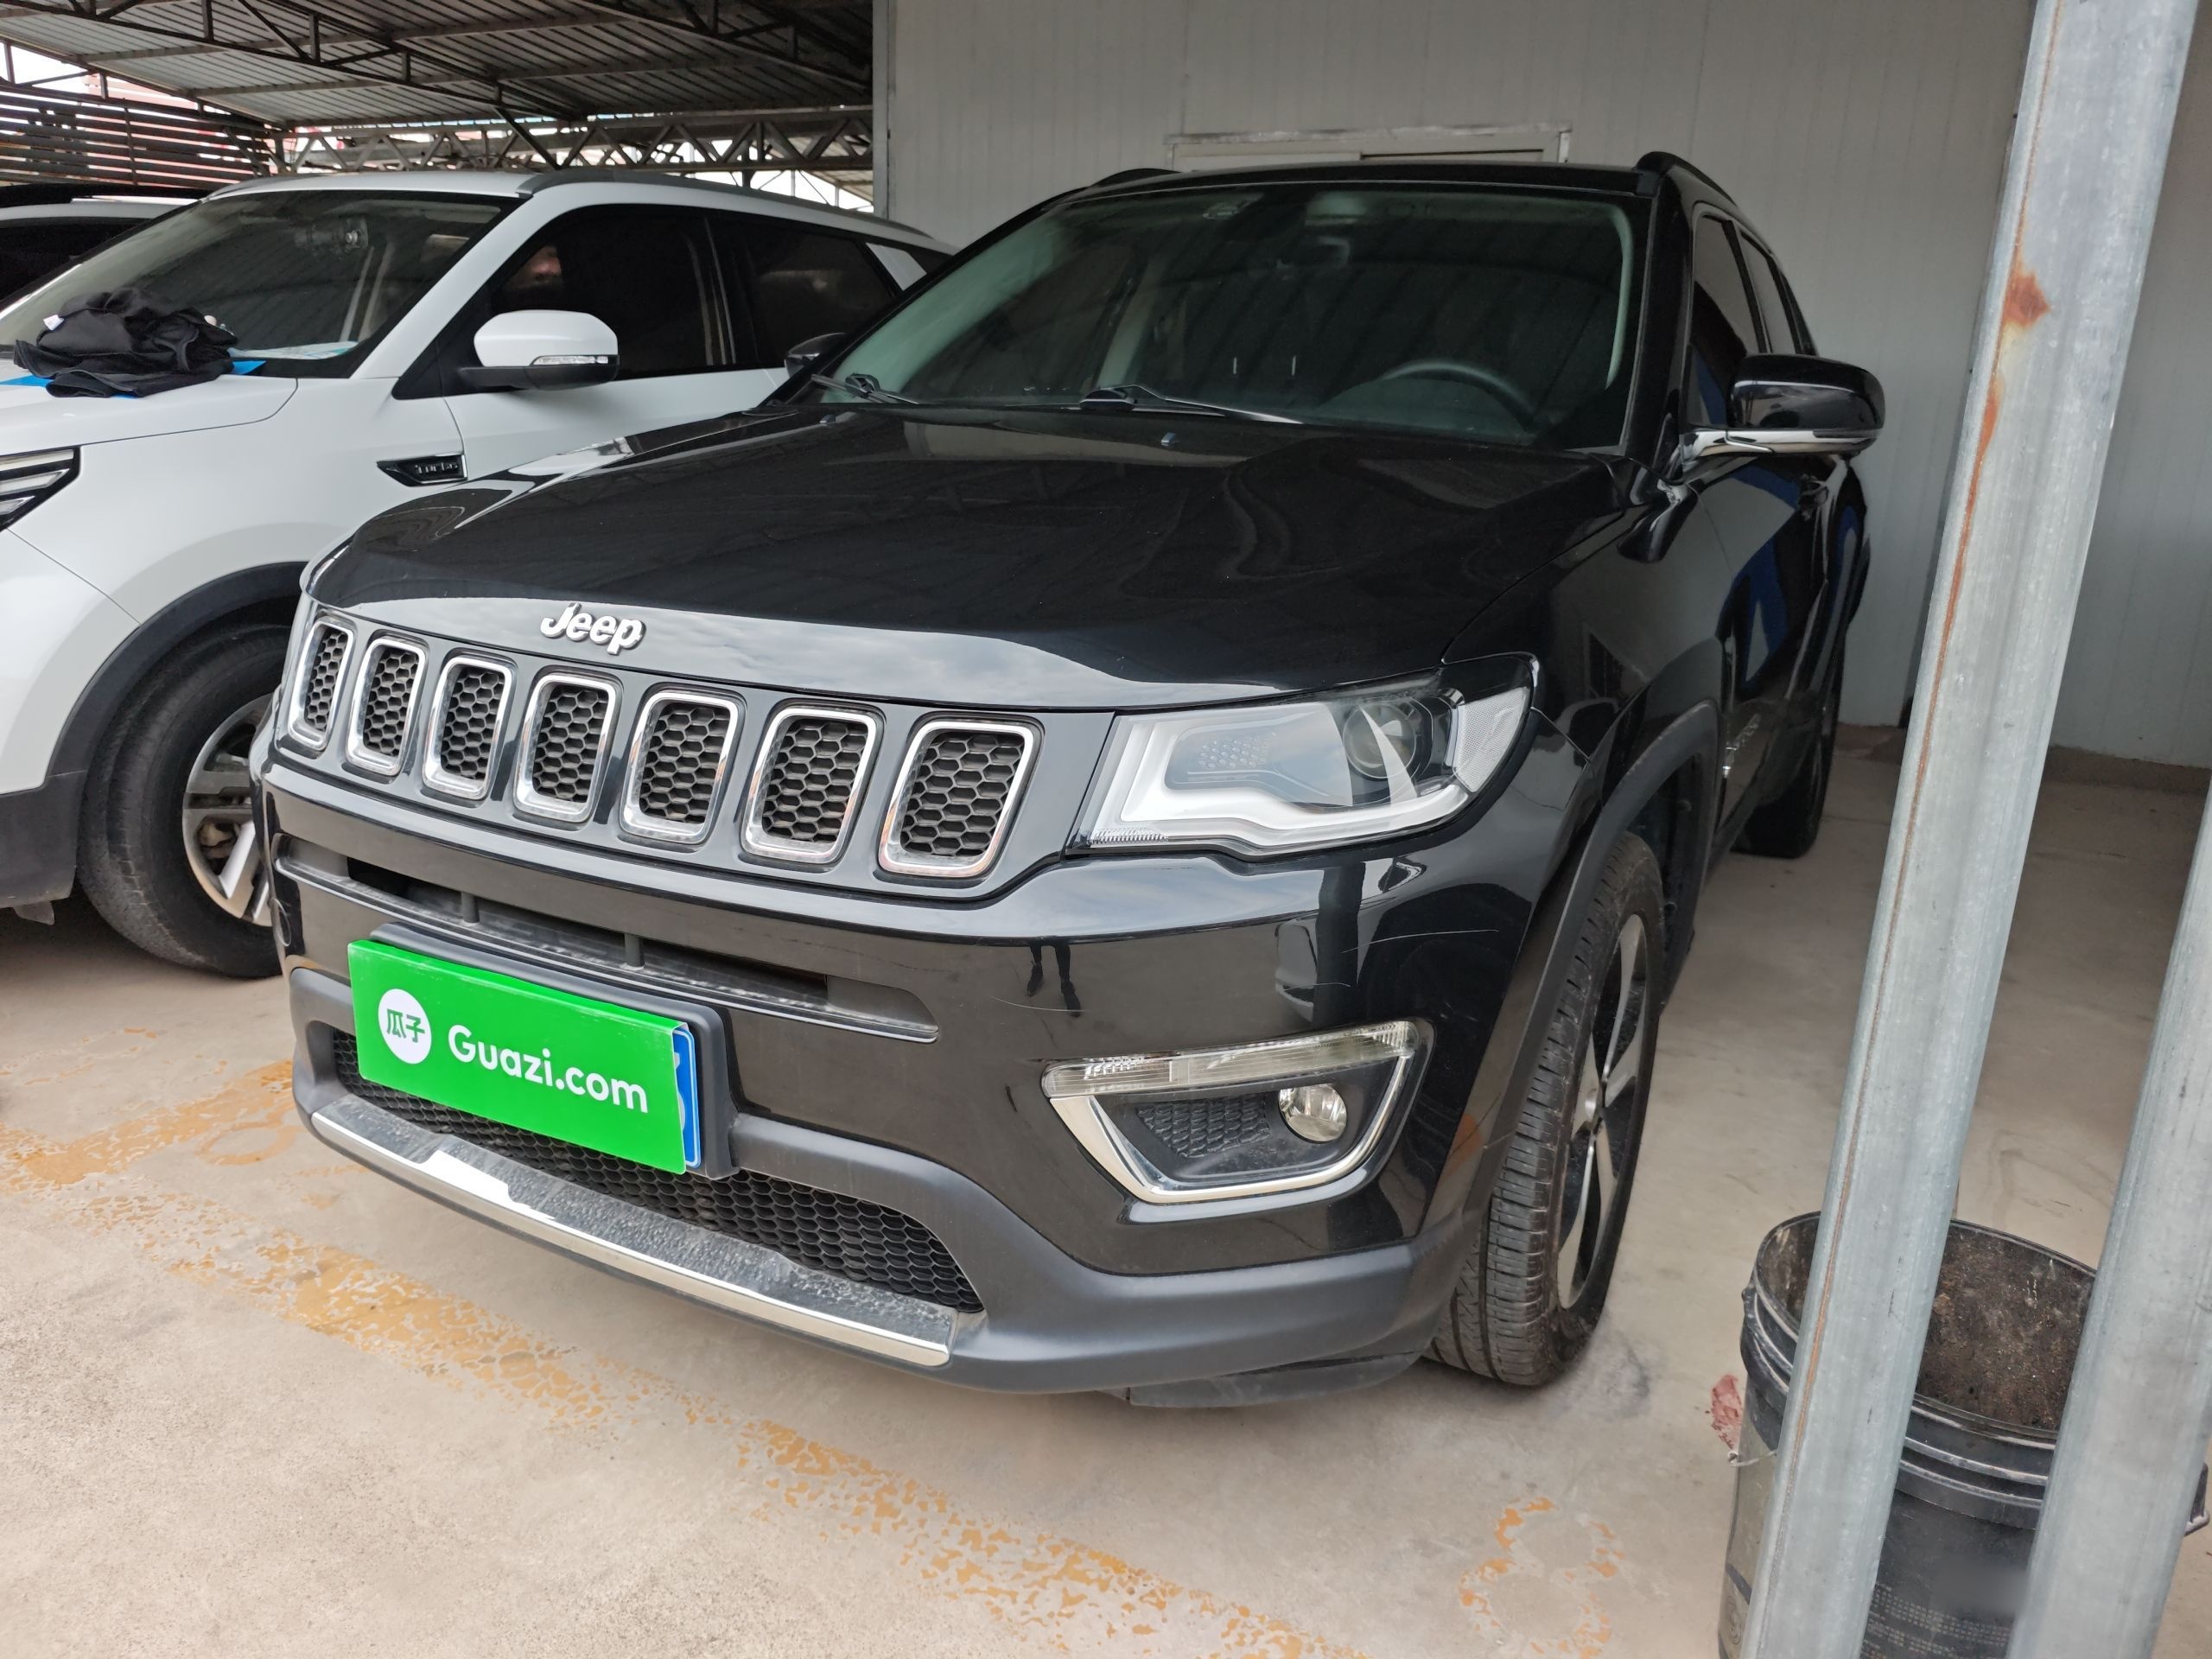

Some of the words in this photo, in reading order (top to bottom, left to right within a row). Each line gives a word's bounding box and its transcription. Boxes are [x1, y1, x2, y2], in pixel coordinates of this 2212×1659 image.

[540, 602, 646, 656] Jeep
[386, 1007, 426, 1044] 瓜子
[448, 1024, 649, 1114] Guazi.com
